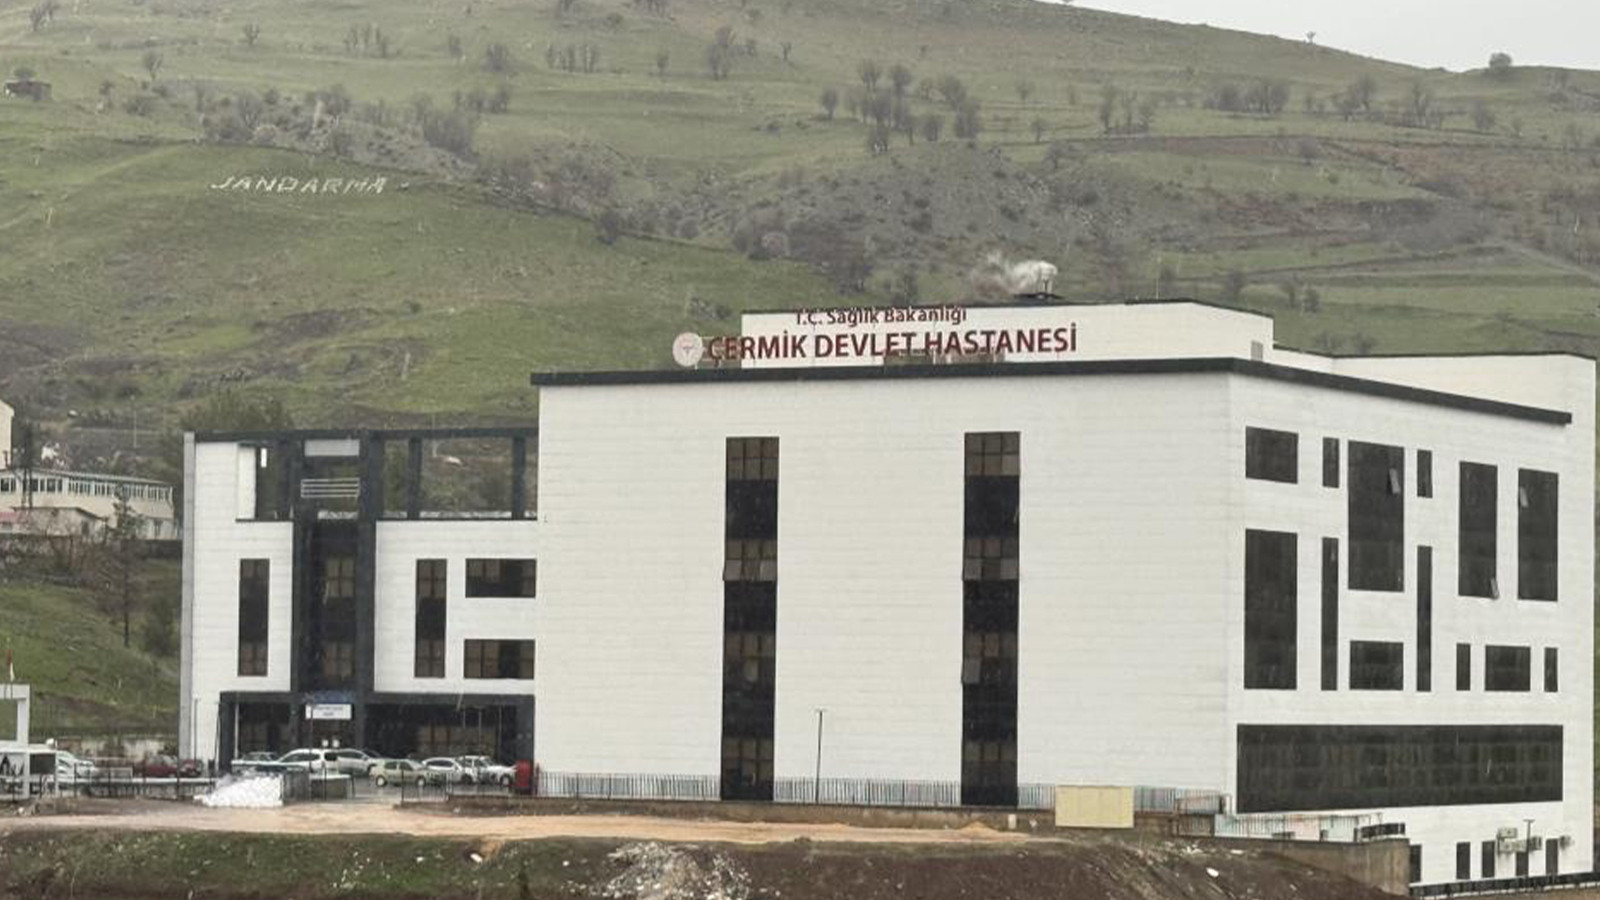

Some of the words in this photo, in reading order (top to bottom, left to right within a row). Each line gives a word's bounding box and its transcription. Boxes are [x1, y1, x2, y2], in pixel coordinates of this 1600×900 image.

[211, 176, 387, 193] JANDARMA
[827, 307, 879, 327] Sağlık
[884, 305, 967, 325] Bakanlığı
[709, 330, 807, 366] ÇERMİK
[815, 333, 917, 357] DEVLET
[925, 322, 1077, 355] HASTANESİ
